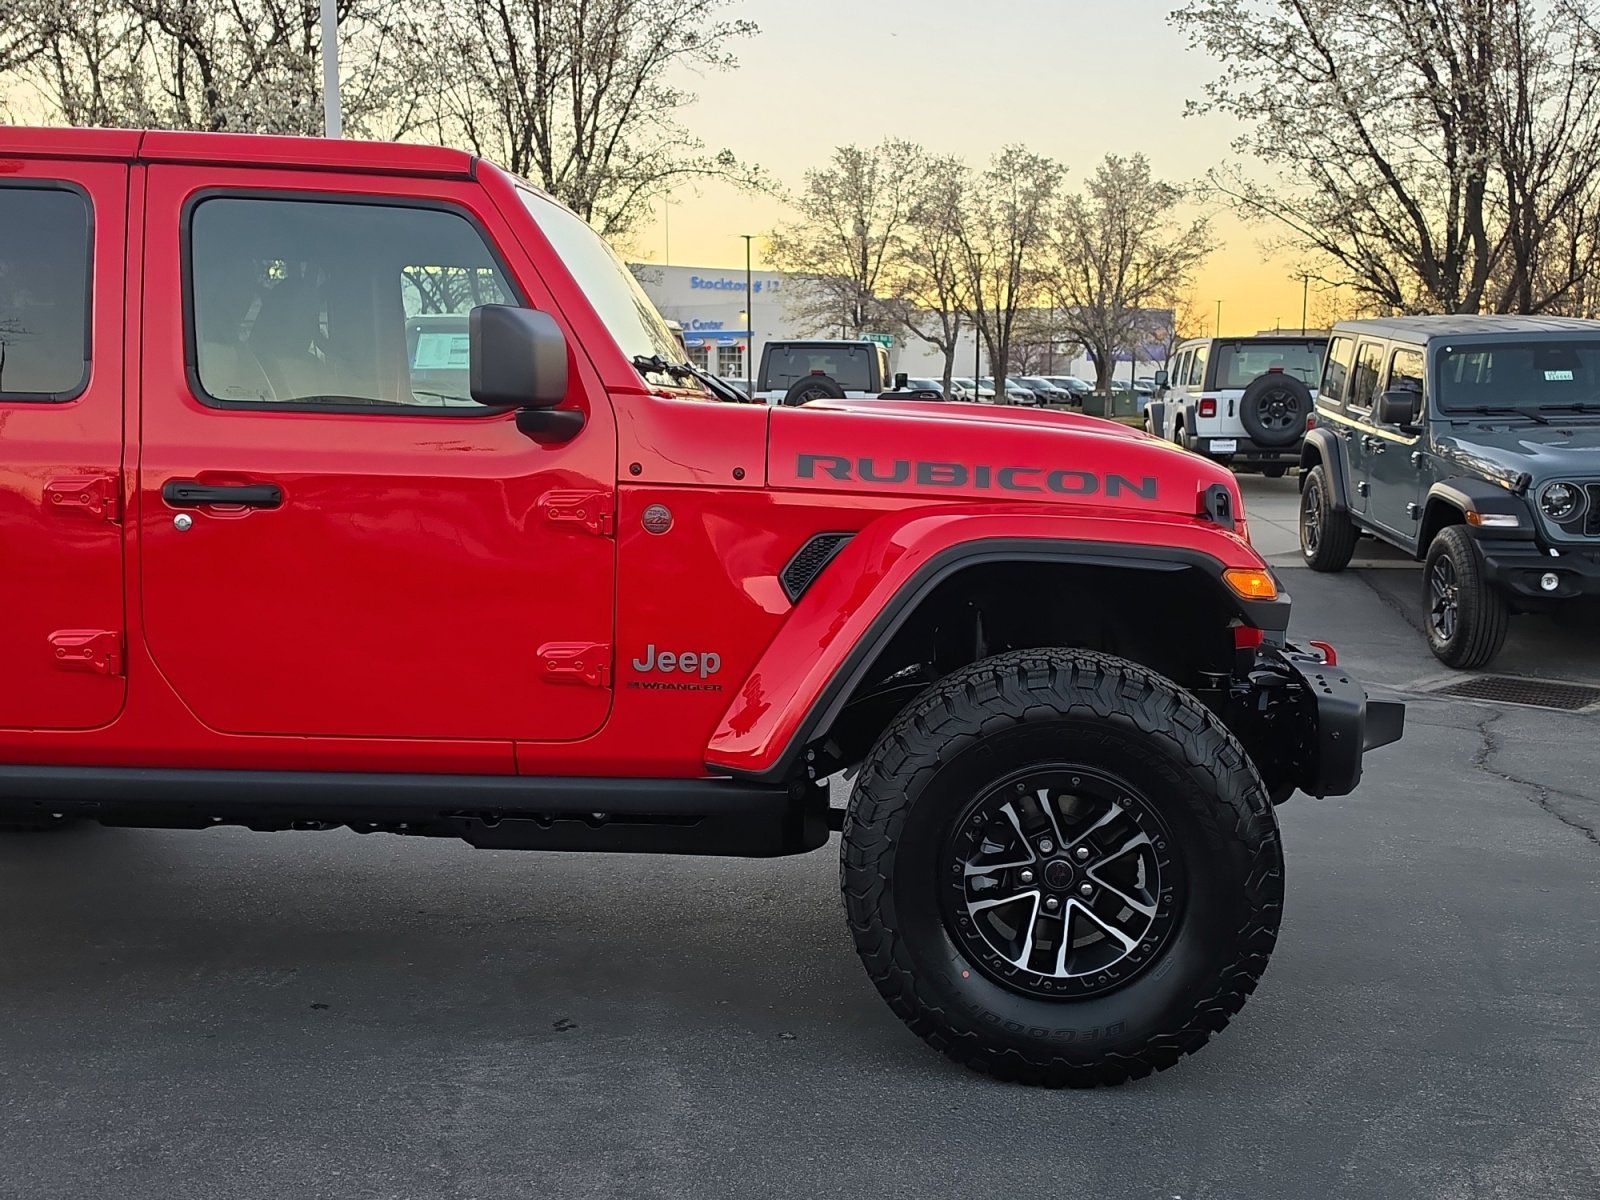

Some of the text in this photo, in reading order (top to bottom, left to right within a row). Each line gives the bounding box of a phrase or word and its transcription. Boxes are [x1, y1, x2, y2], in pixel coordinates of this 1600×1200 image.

[690, 276, 750, 291] Stockton
[692, 319, 724, 330] Center
[728, 363, 736, 378] 2
[795, 453, 1159, 499] RUBICON
[632, 644, 721, 679] Jeep
[642, 681, 723, 693] WRANGLER
